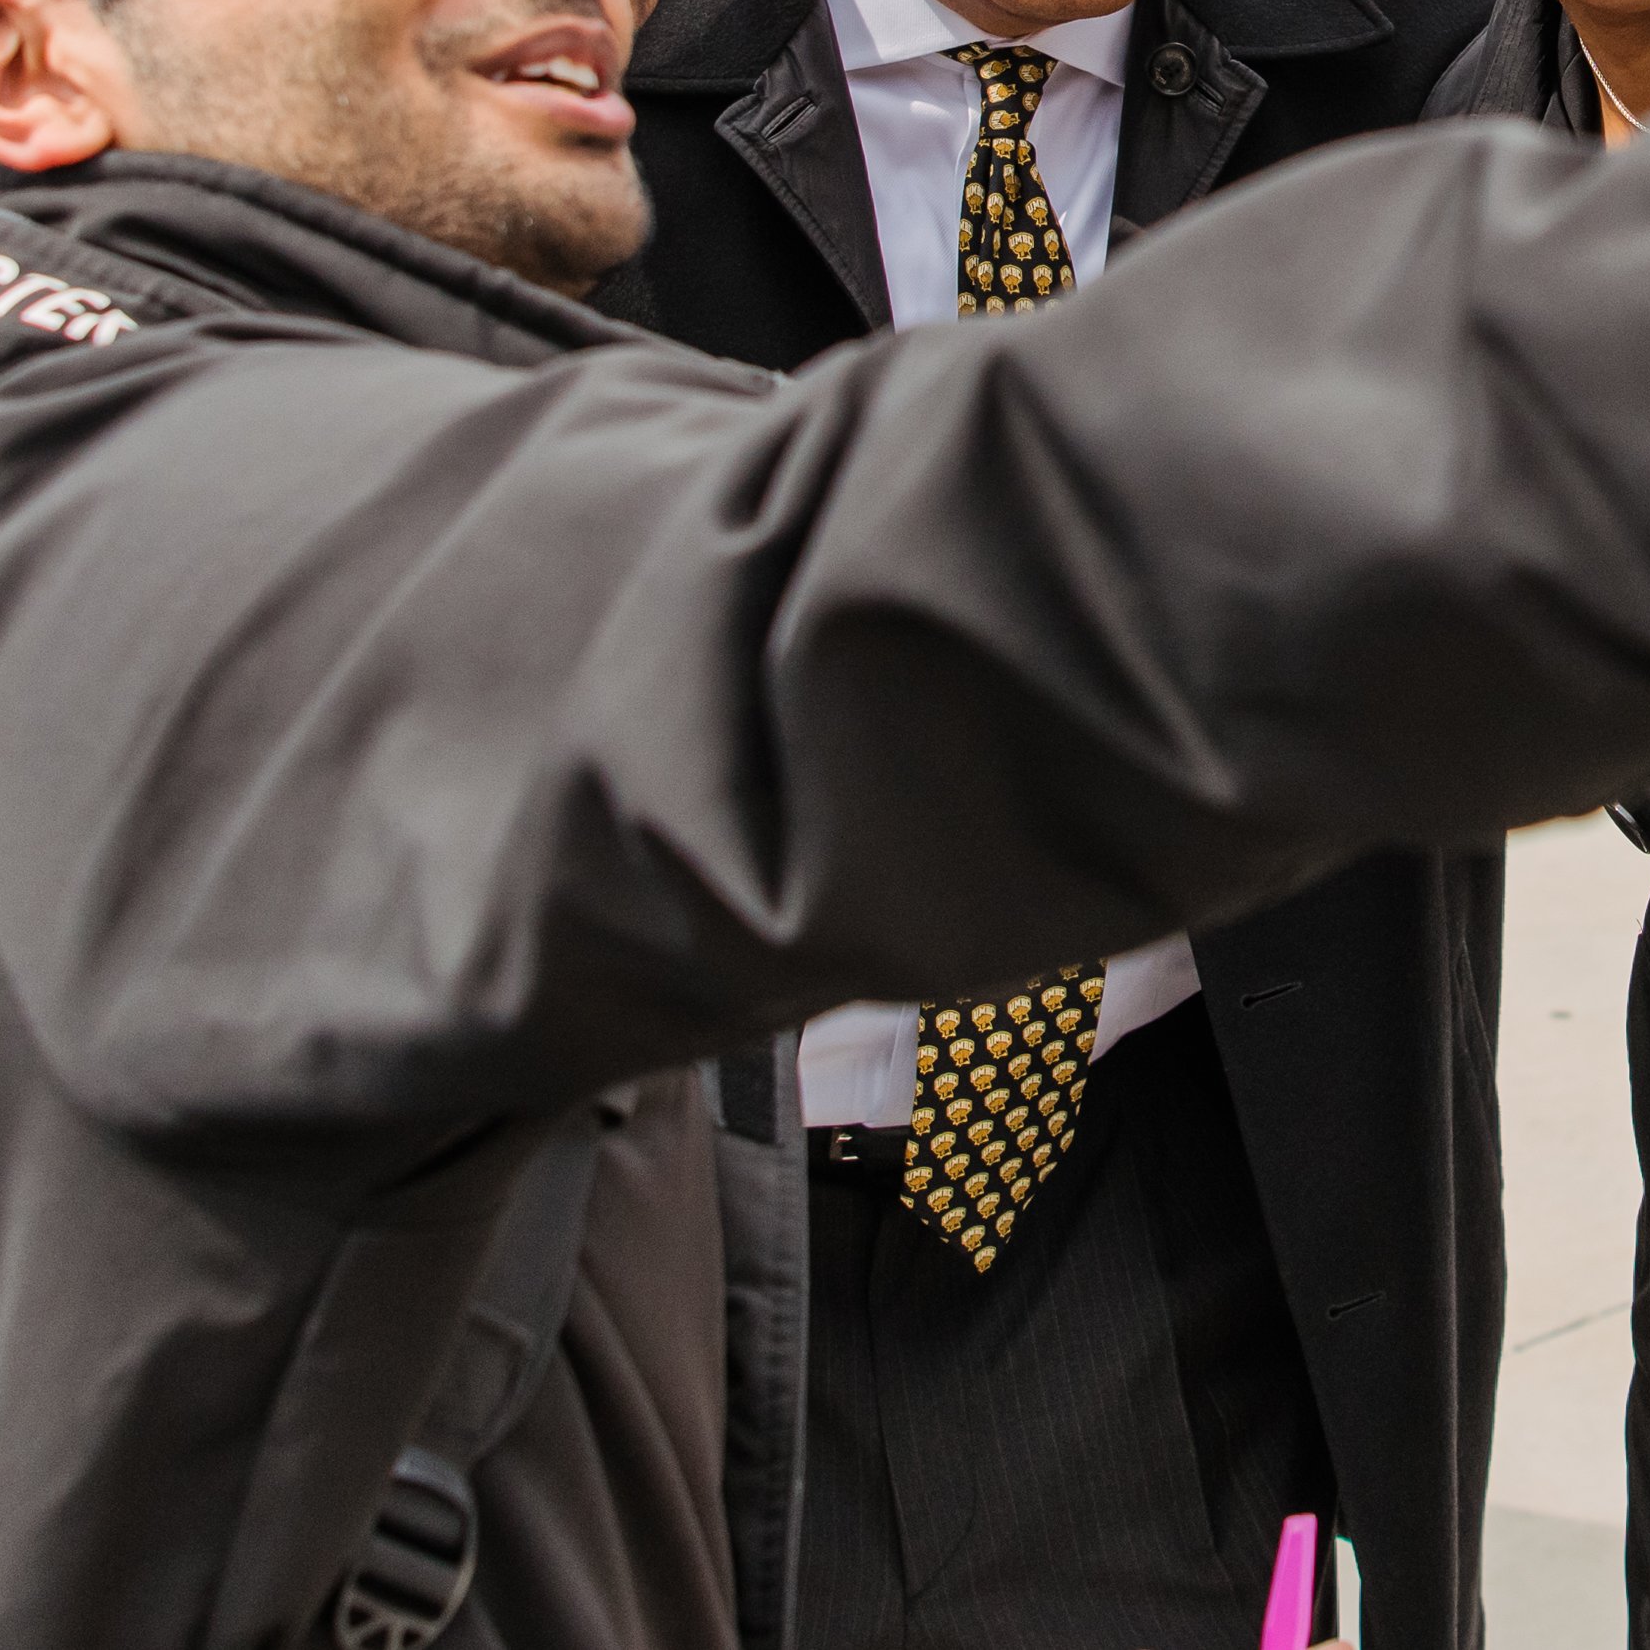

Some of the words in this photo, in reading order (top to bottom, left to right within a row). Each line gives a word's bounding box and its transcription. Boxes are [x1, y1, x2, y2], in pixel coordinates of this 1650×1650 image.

[1009, 234, 1034, 248] UMBC
[1042, 987, 1067, 1004] UMBC
[972, 1005, 996, 1021] UMBC
[1008, 997, 1031, 1014] UMBC
[937, 1011, 960, 1028] UMBC
[950, 1040, 974, 1053] UMBC
[988, 1033, 1012, 1049] UMBC
[935, 1074, 959, 1090] UMBC
[971, 1066, 996, 1083] UMBC
[912, 1109, 935, 1124] UMBC
[947, 1100, 972, 1117] UMBC
[931, 1133, 956, 1151] UMBC
[905, 1168, 932, 1183] UMBC
